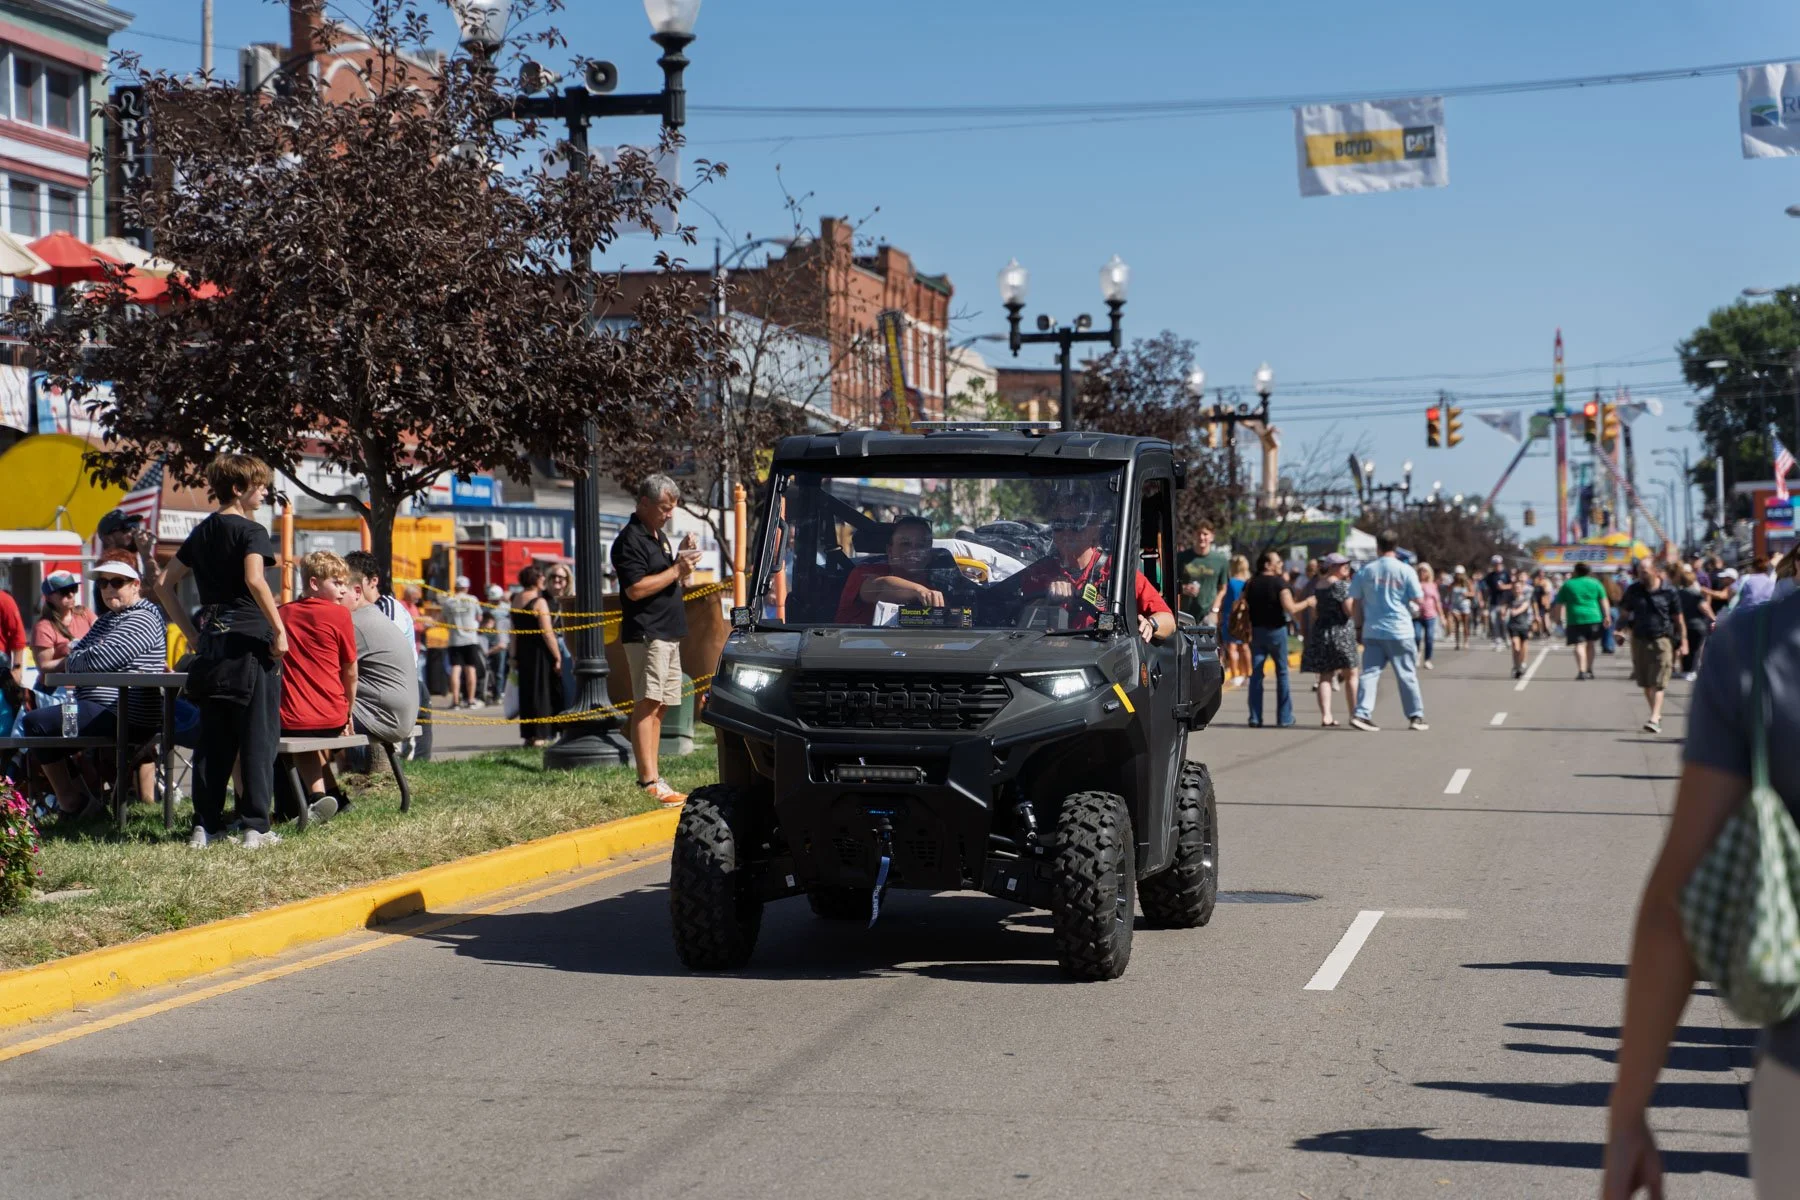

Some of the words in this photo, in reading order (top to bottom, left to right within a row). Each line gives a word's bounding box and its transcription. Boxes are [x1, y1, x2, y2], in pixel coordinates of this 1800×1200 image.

[1783, 96, 1800, 113] R
[1334, 139, 1373, 157] BOYD
[1405, 133, 1432, 152] CAT
[826, 690, 962, 710] POLARIS
[871, 885, 882, 921] POLARIS
